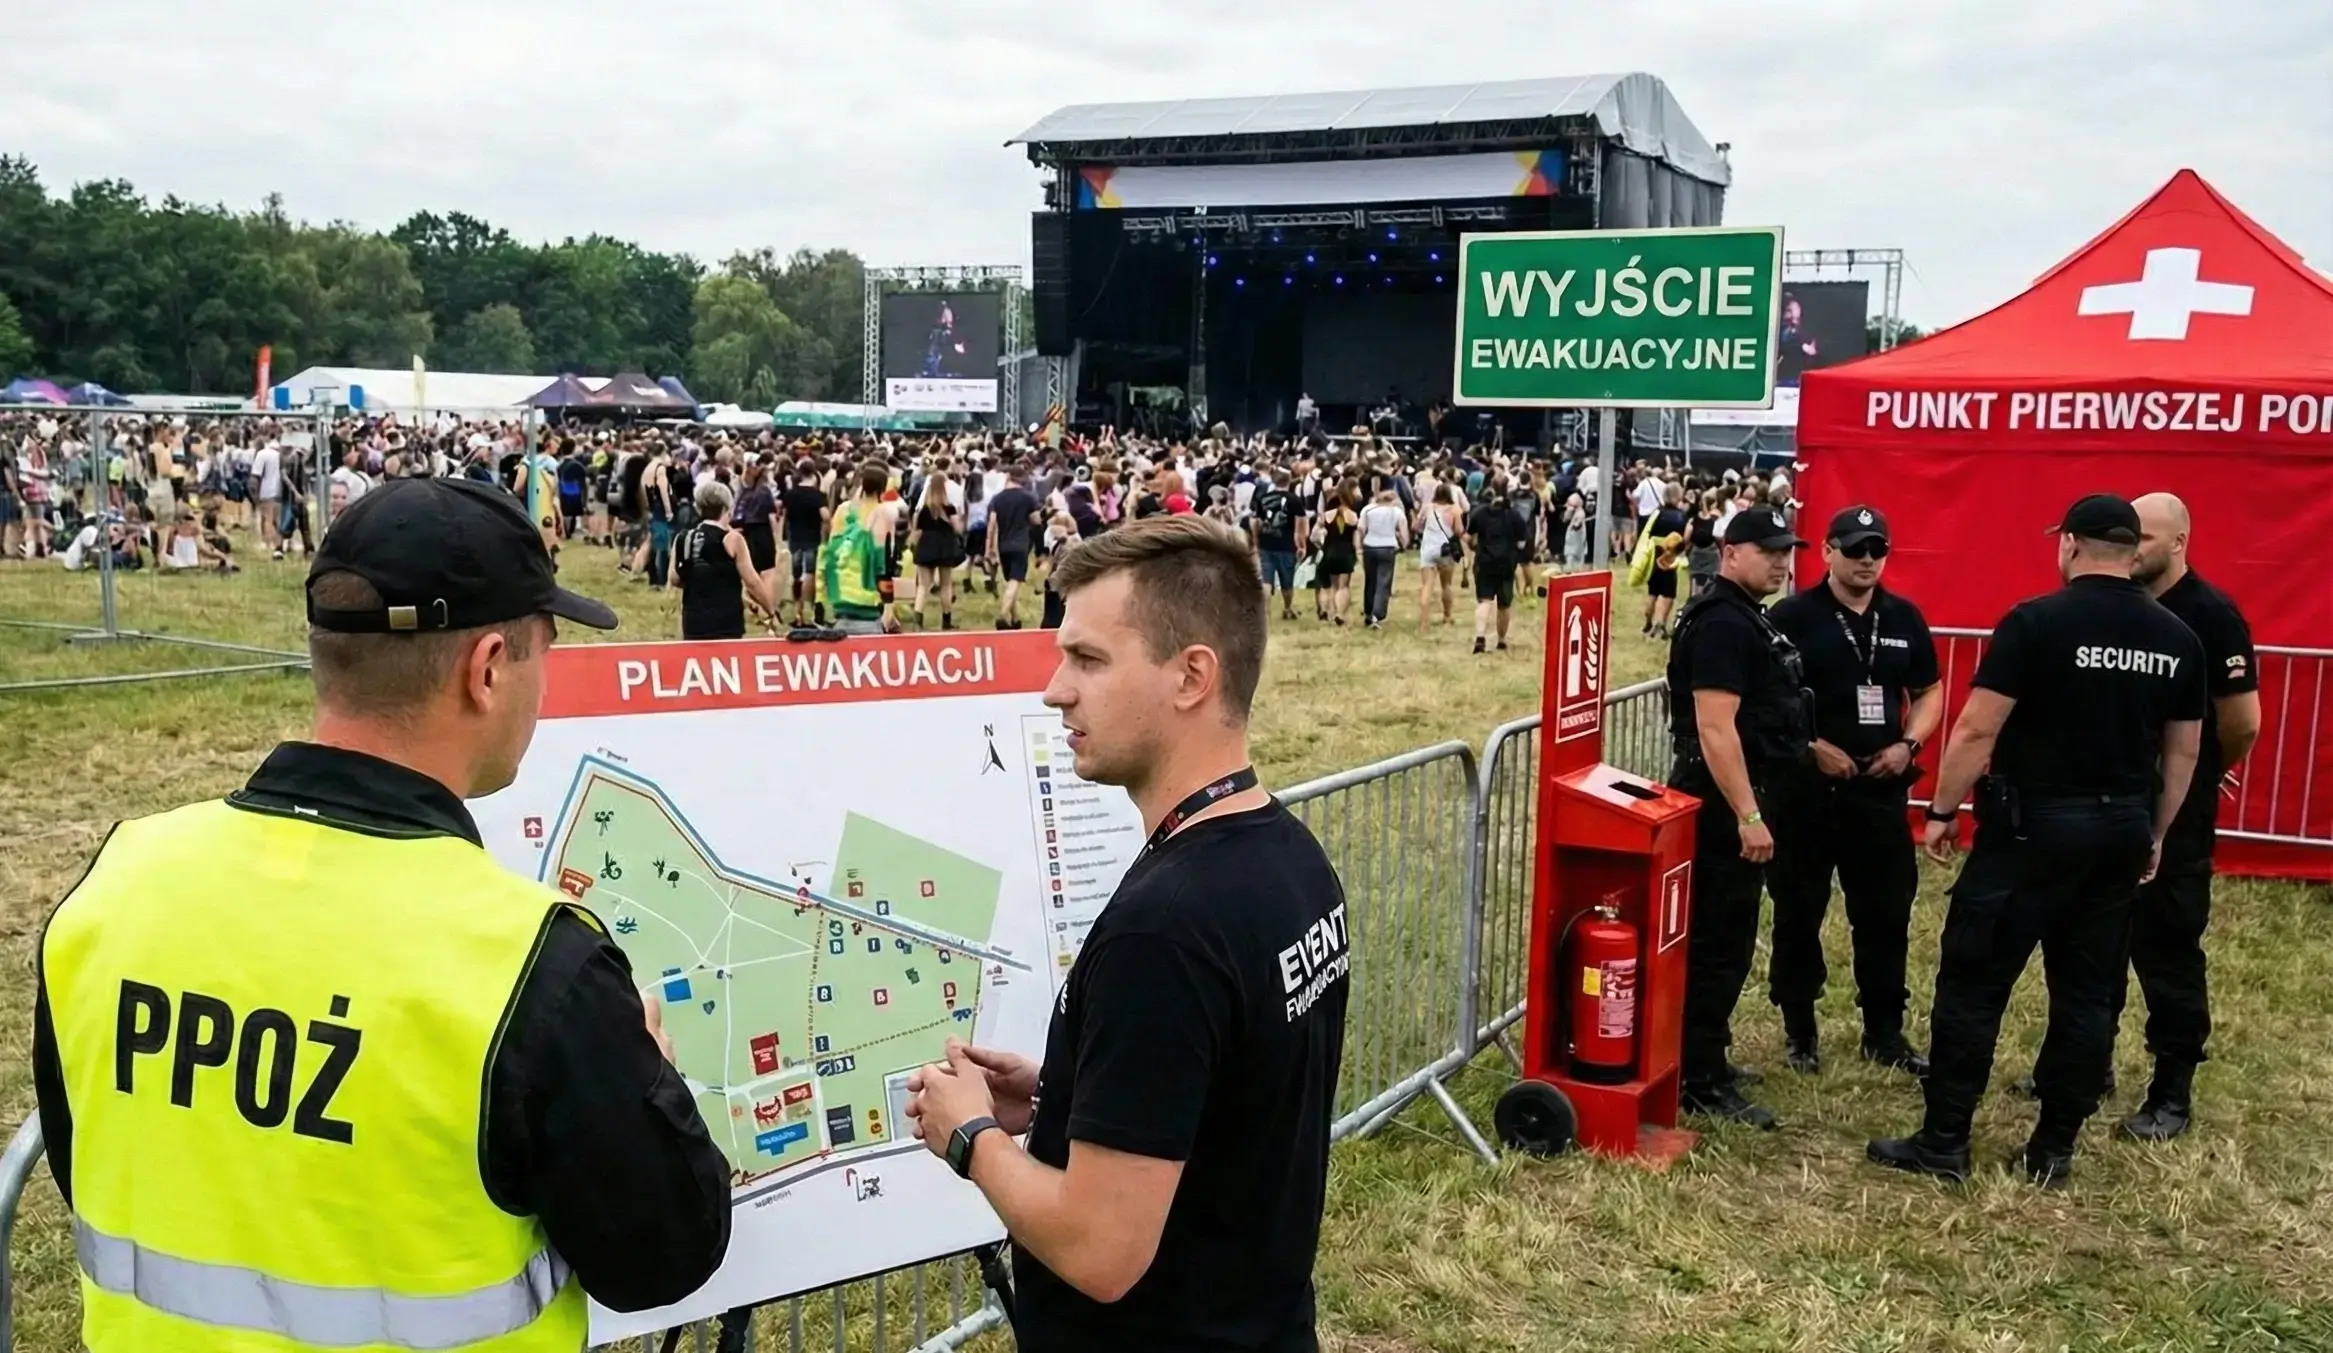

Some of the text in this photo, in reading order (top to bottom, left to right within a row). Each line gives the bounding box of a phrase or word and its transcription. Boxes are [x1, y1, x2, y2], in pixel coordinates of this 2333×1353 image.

[1480, 255, 1755, 317] WYJŚCIE
[1471, 338, 1757, 370] EWAKUACYJNE
[1867, 391, 1998, 430] PUNKT
[2009, 392, 2244, 432] PIERWSZEJ
[617, 646, 995, 701] PLAN EWAKUACJI
[2075, 645, 2181, 679] SECURITY
[983, 723, 994, 737] N
[1278, 902, 1348, 994] EVENT
[115, 979, 362, 1145] PPOŻ
